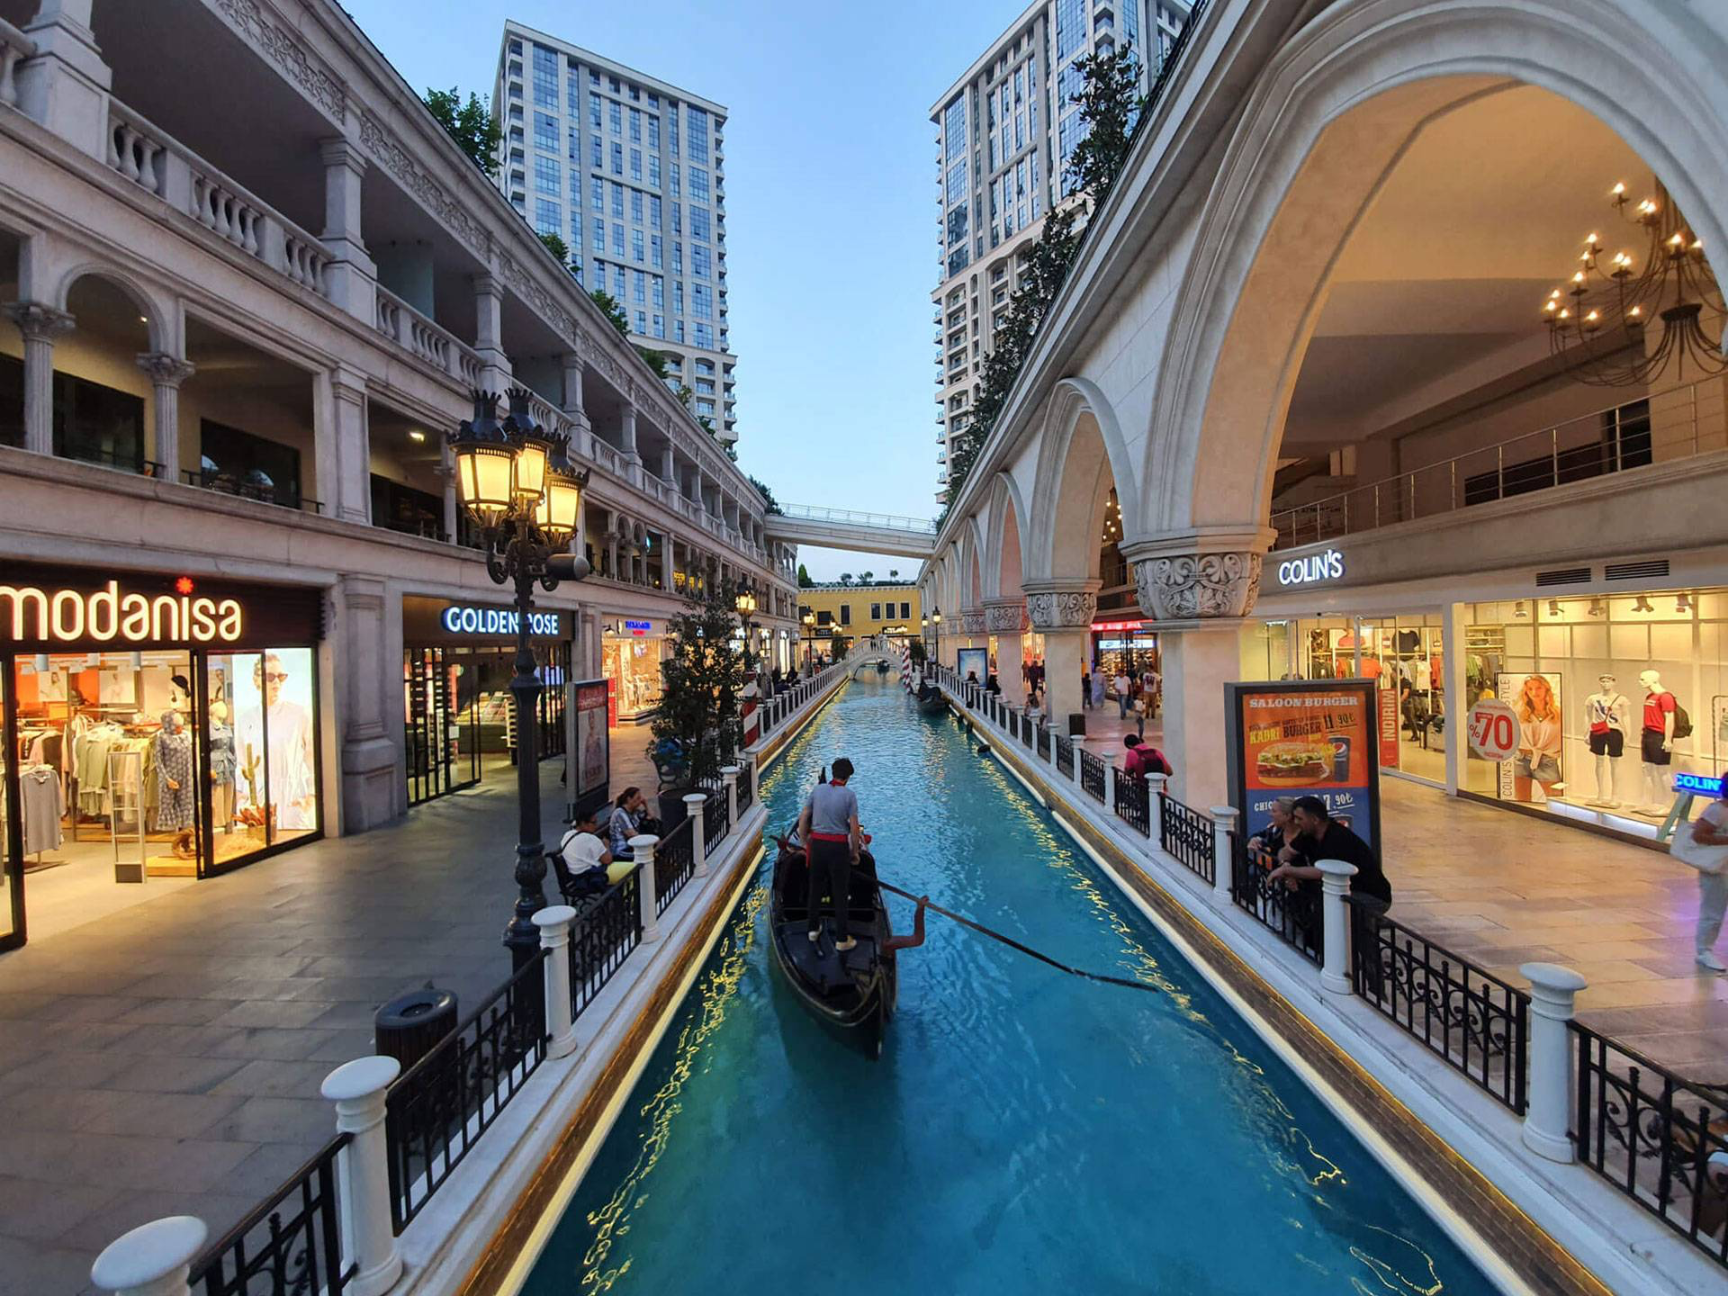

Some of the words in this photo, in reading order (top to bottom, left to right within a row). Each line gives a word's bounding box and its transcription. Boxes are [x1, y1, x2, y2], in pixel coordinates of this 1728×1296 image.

[1279, 549, 1343, 585] COLIN'S
[0, 577, 242, 642] modanisa
[446, 606, 519, 634] GOLDEN
[1250, 698, 1302, 708] SALOON
[1305, 696, 1358, 707] BURGER
[1254, 801, 1273, 811] CHIC
